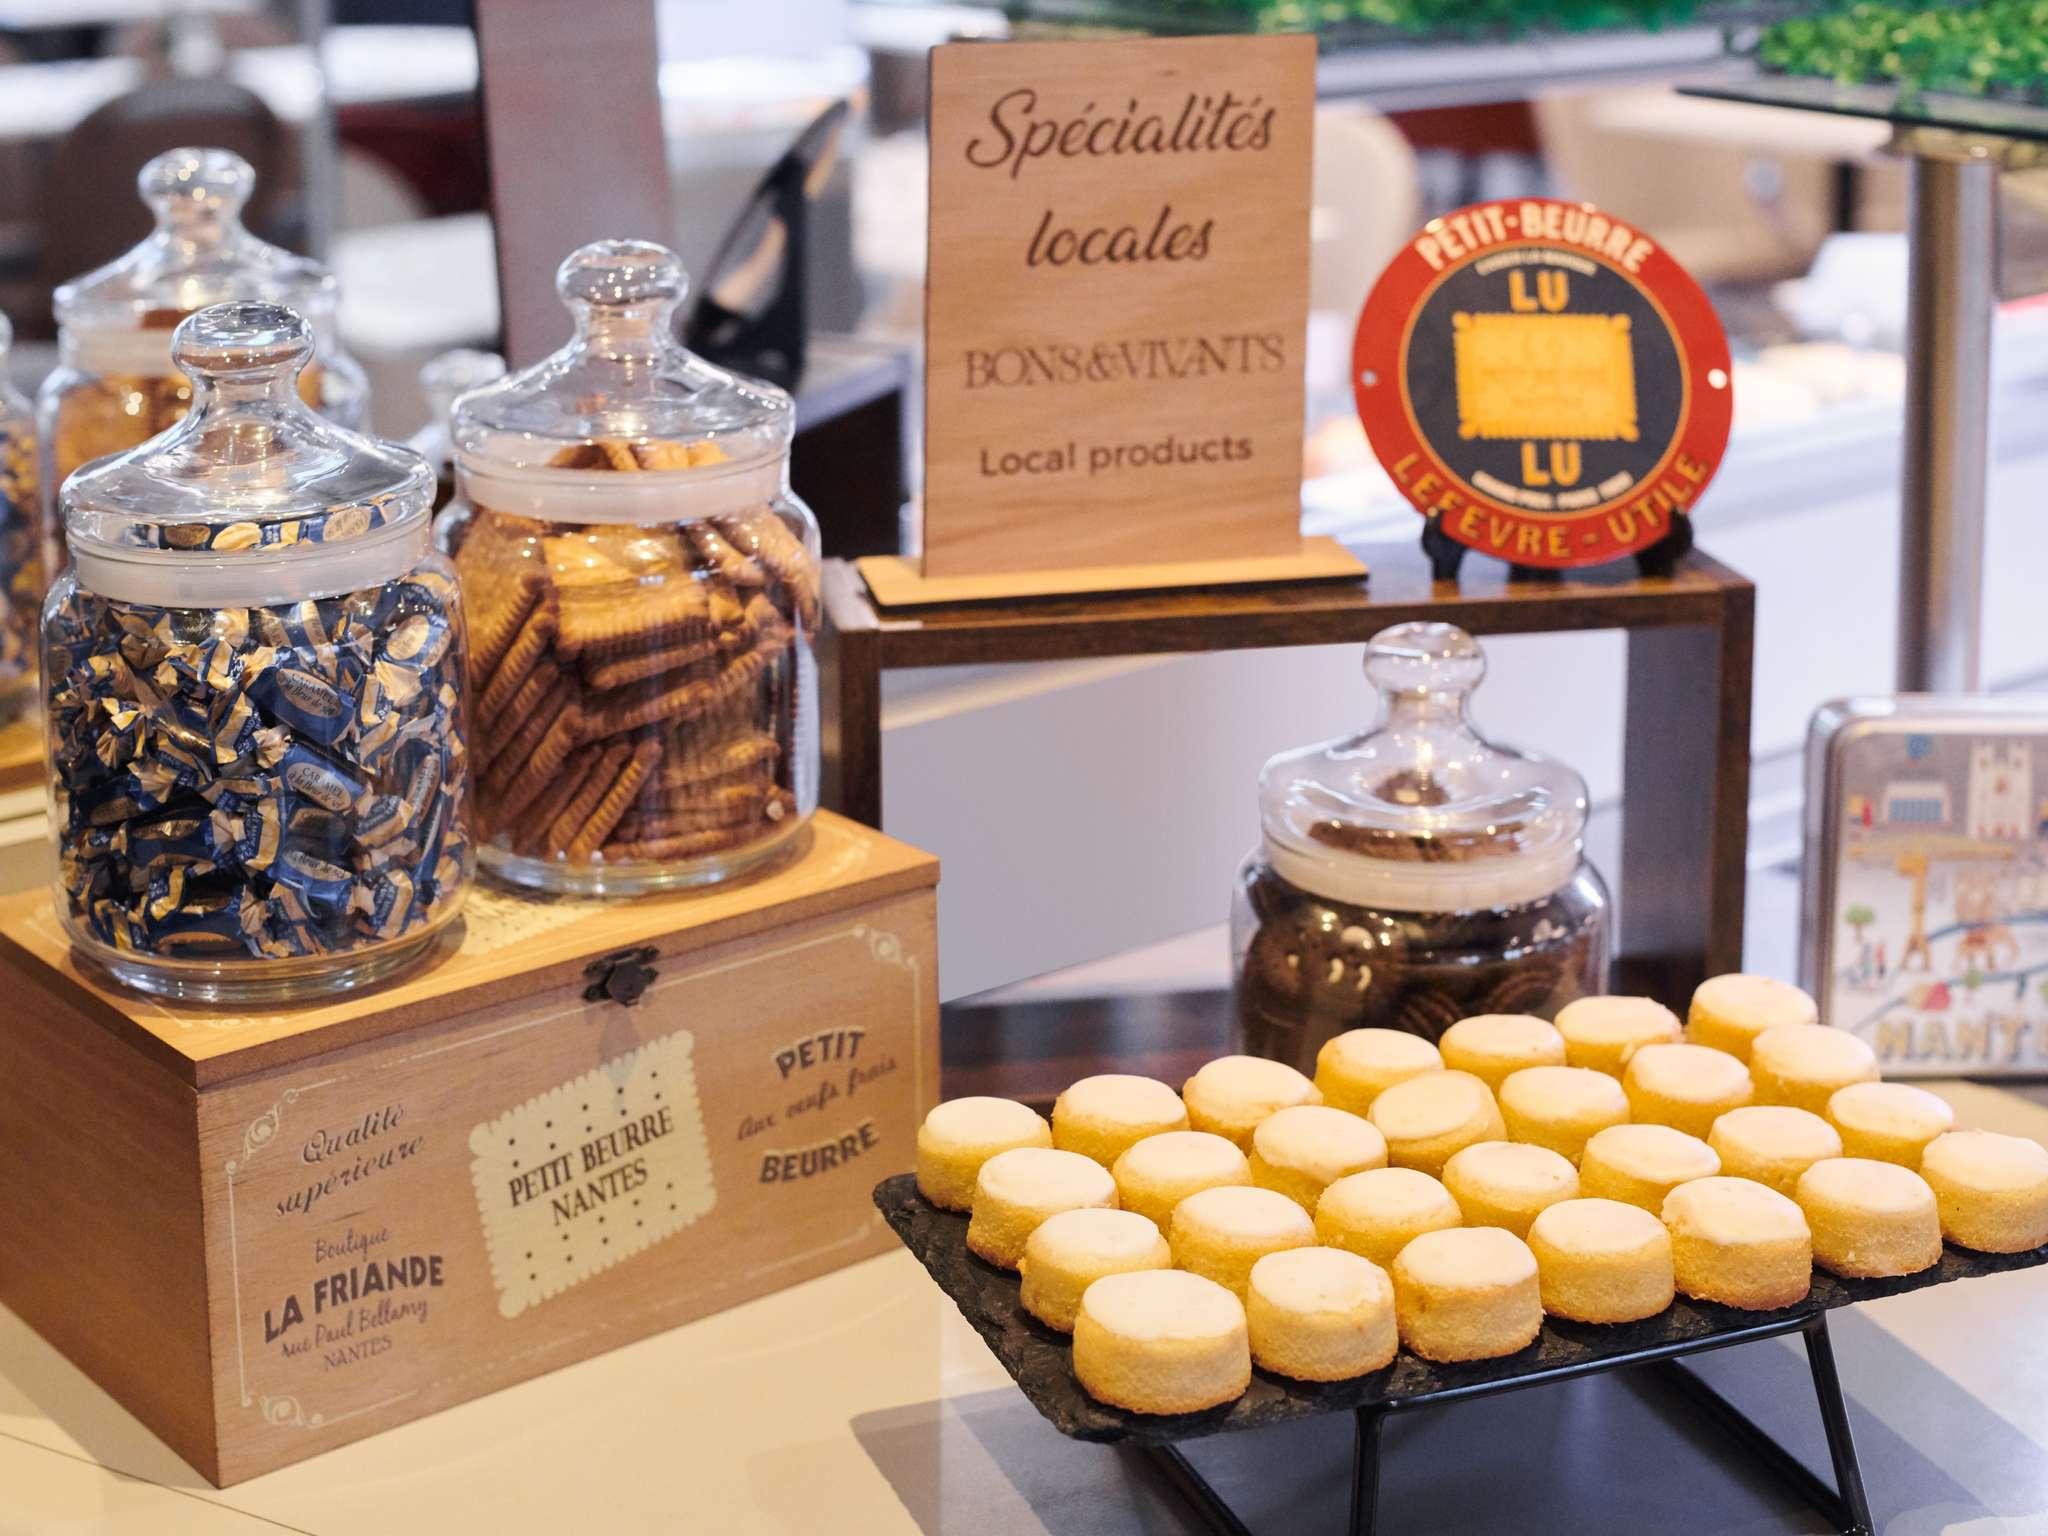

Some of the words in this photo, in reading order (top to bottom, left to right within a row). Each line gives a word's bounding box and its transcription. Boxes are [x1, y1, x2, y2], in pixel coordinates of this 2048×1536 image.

[966, 88, 1276, 179] Spécialités
[1027, 205, 1215, 267] locales
[1509, 270, 1569, 312] LU
[965, 332, 1286, 389] BONS&VIVANTS
[980, 442, 1076, 476] Local
[1090, 435, 1253, 474] products
[1521, 442, 1581, 486] LU
[776, 1031, 865, 1079] PETIT
[848, 1057, 897, 1096] frais
[304, 1104, 404, 1163] Qualité
[509, 1152, 573, 1207] PETIT
[582, 1106, 674, 1172] BEURRE
[760, 1122, 880, 1184] BEURRE
[277, 1136, 423, 1217] supérieure
[551, 1158, 648, 1226] NANTES
[314, 1228, 390, 1264] Boutique
[264, 1294, 304, 1343] LA
[314, 1256, 444, 1315] FRIANDE
[315, 1310, 353, 1347] Paul
[323, 1334, 392, 1372] NANTES
